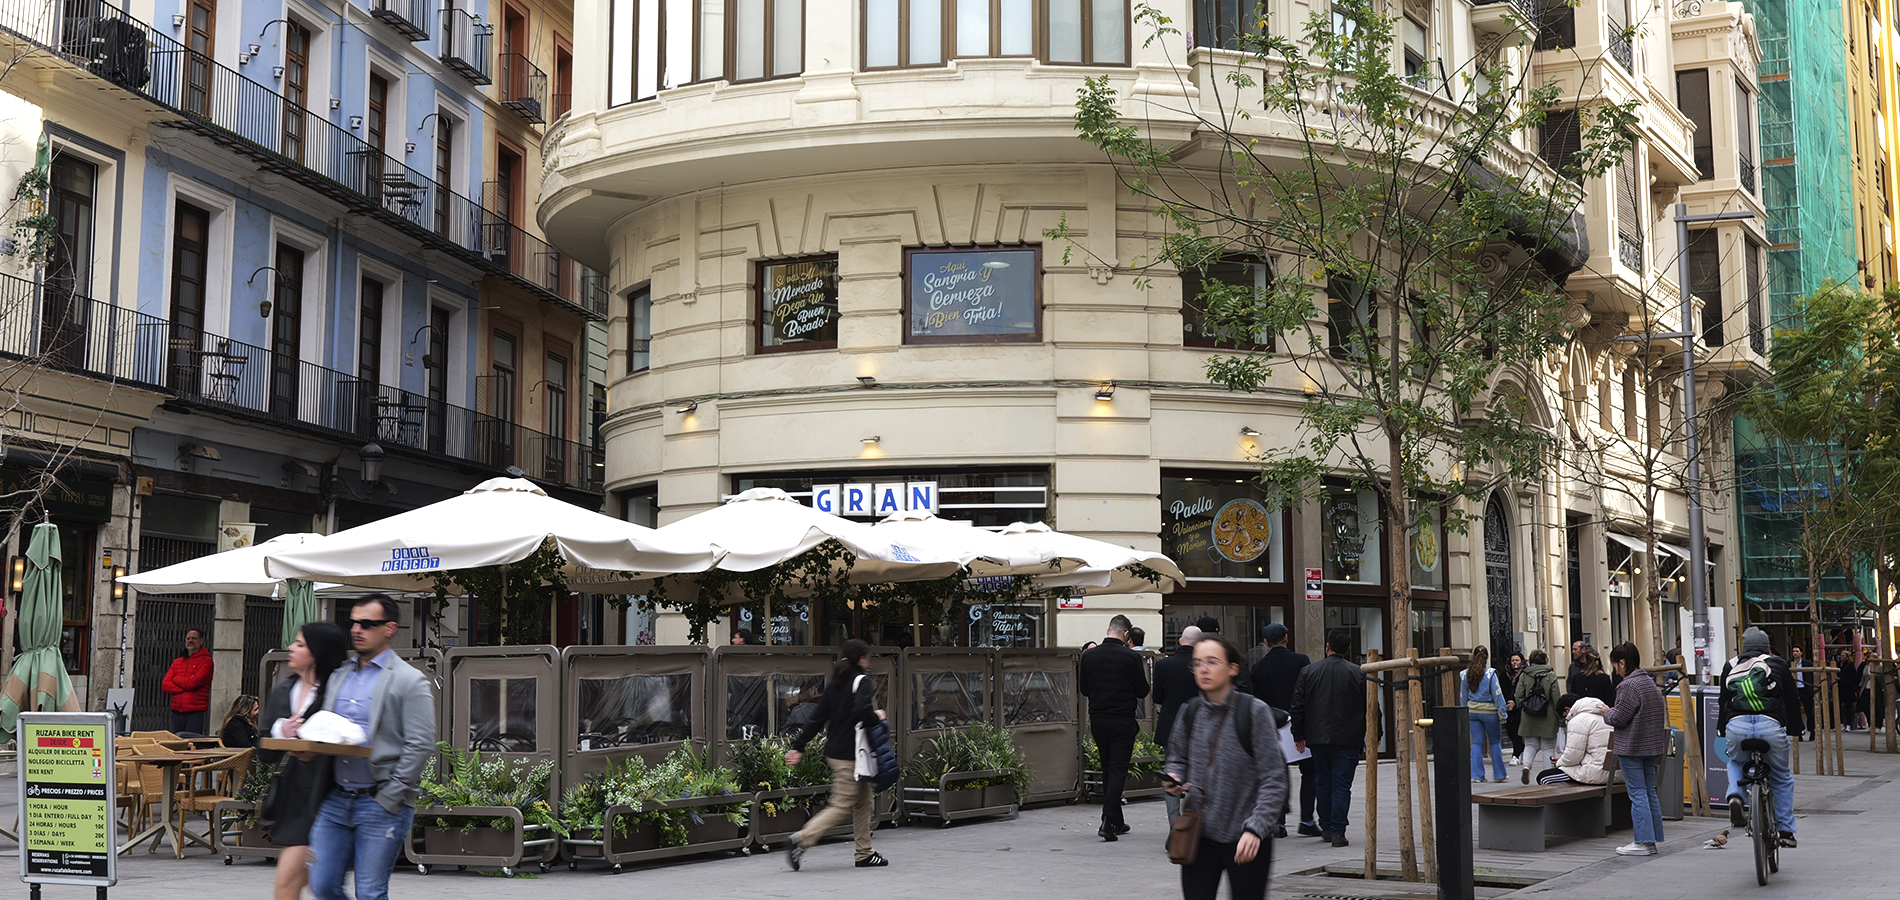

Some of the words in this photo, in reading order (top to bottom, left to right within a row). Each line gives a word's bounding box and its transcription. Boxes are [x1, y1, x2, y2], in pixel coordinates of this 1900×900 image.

[923, 269, 978, 294] Sangría
[979, 266, 994, 282] Y
[772, 277, 824, 305] Mercado
[808, 292, 826, 305] Un
[930, 284, 995, 310] Cerveza
[797, 306, 826, 323] Buen
[817, 486, 931, 513] GRAN
[1170, 496, 1215, 520] Paella
[1172, 519, 1213, 536] Valenciana
[394, 548, 428, 559] GRAN
[1176, 539, 1207, 556] Marisco
[382, 558, 439, 571] MERCAT
[36, 729, 61, 737] RUZAFA
